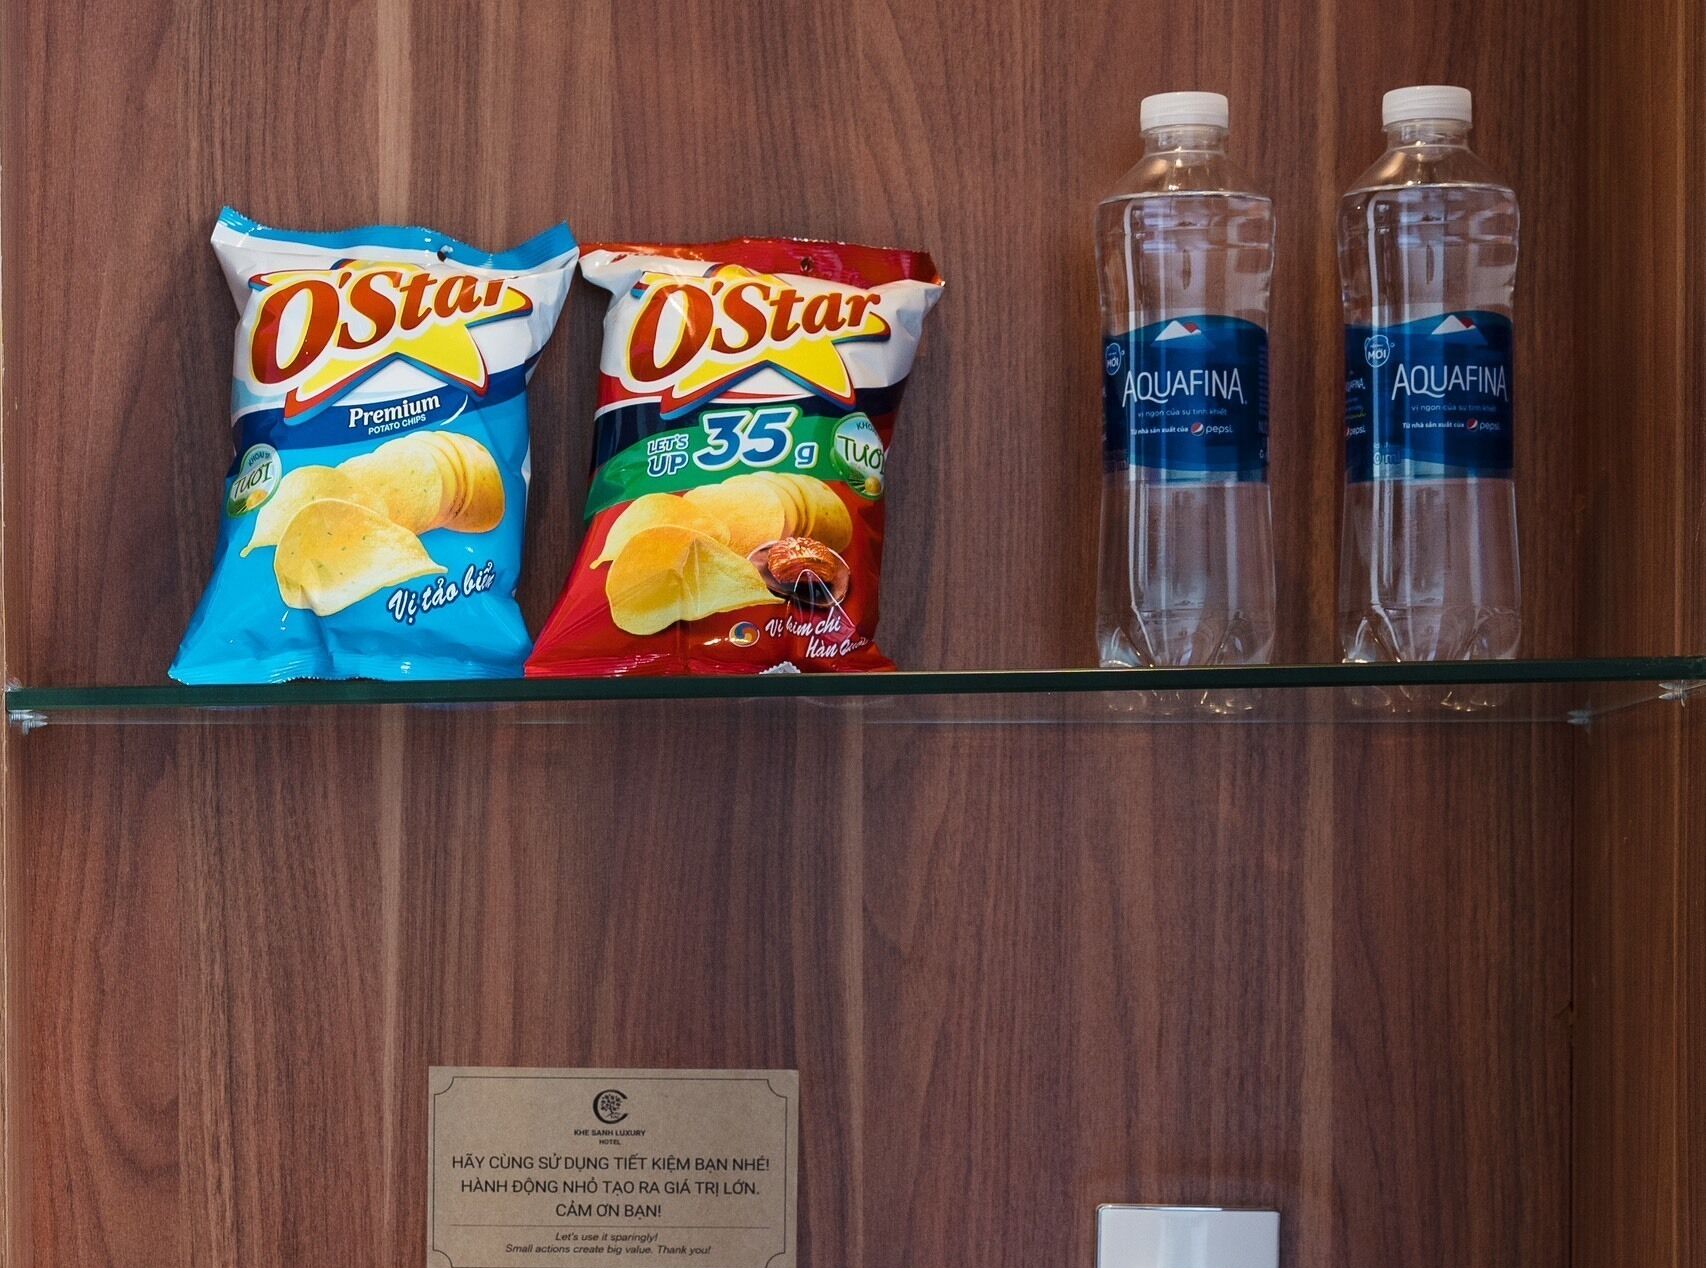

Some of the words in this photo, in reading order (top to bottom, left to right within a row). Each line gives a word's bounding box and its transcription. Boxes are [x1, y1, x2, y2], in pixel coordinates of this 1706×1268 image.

[629, 281, 882, 383] O'Star
[1122, 368, 1244, 408] AQUAFINA
[1391, 363, 1509, 402] AQUAFINA
[348, 393, 441, 429] Premium
[368, 420, 401, 435] POTATO
[402, 413, 427, 430] CHIPS
[1205, 424, 1233, 435] pepsi
[648, 433, 689, 454] LET'S
[694, 409, 797, 469] 35
[796, 444, 817, 468] g
[648, 452, 688, 477] UP
[388, 589, 417, 623] Vị
[422, 577, 459, 610] tảo
[765, 618, 783, 638] Vị
[786, 615, 813, 637] kim
[805, 636, 838, 659] Hàn
[573, 1129, 590, 1137] KHE
[591, 1129, 614, 1137] SANH
[615, 1129, 646, 1137] LUXURY
[451, 1153, 485, 1169] HÃY
[489, 1153, 534, 1170] CÙNG
[538, 1153, 562, 1170] SỬ
[564, 1156, 609, 1173] DỤNG
[613, 1153, 648, 1170] TIẾT
[652, 1154, 691, 1174] KIỆM
[695, 1157, 728, 1174] BẠN
[732, 1154, 770, 1171] NHÉ!
[461, 1177, 508, 1193] HÀNH
[512, 1177, 558, 1196] ĐỘNG
[563, 1176, 598, 1194] NHỎ
[602, 1180, 635, 1197] TẠO
[639, 1181, 659, 1194] RA
[664, 1178, 691, 1194] GIÁ
[695, 1181, 720, 1197] TRỊ
[723, 1178, 760, 1195] LỚN.
[555, 1199, 592, 1217] CẢM
[596, 1203, 620, 1217] ƠN
[624, 1203, 662, 1220] BẠN!
[555, 1232, 579, 1242] Let's
[581, 1233, 599, 1242] use
[601, 1232, 610, 1242] it
[610, 1232, 659, 1244] sparingly!
[506, 1243, 533, 1253] Small
[535, 1244, 570, 1254] actions
[573, 1245, 605, 1254] create
[607, 1245, 623, 1256] big
[625, 1245, 653, 1255] value.
[657, 1245, 687, 1255] Thank
[689, 1245, 712, 1256] you!
